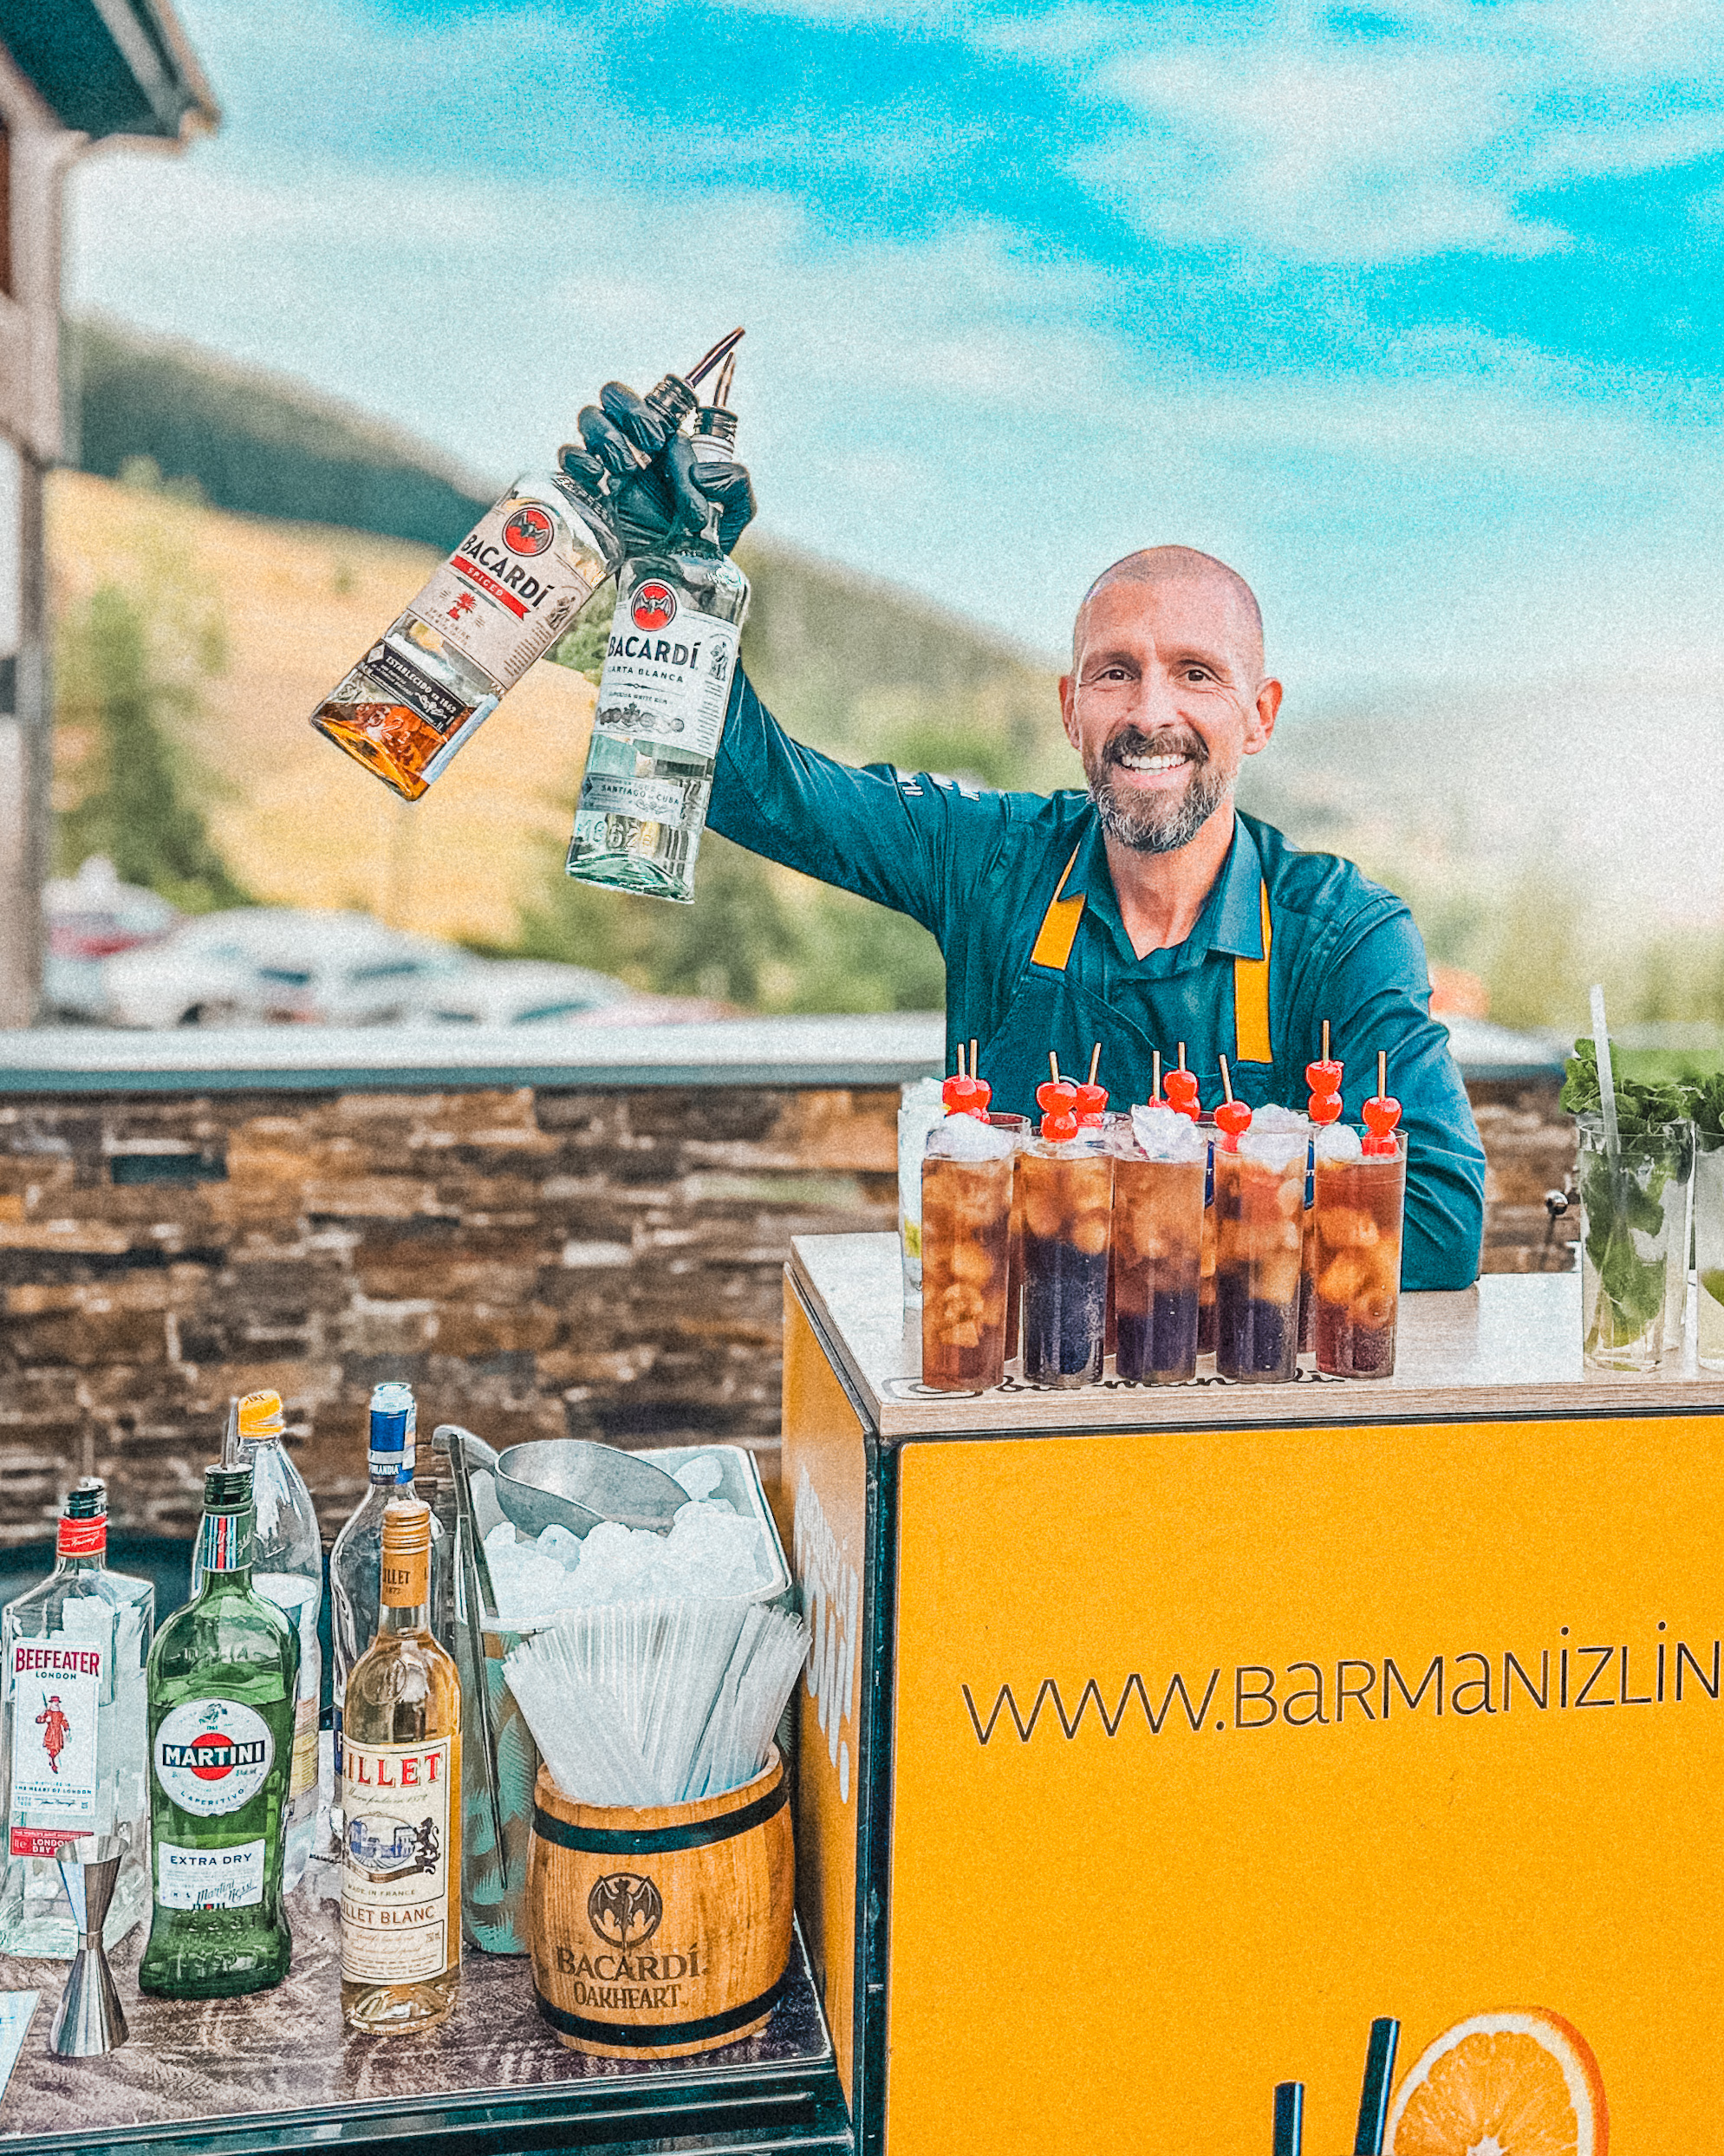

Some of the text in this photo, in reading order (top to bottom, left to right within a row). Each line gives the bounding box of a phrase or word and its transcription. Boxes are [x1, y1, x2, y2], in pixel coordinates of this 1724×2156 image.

[460, 534, 556, 608] BACARDÍ
[466, 566, 504, 597] SPICED
[608, 636, 702, 669] BACARDÍ
[385, 655, 433, 694] ESTABLECIDO
[638, 668, 683, 683] BLANCA
[601, 785, 647, 798] SANTIAGO
[656, 794, 679, 804] CUBA
[16, 1647, 100, 1677] BEEFEATER
[36, 1671, 76, 1680] LONDON
[166, 1742, 263, 1767] MARTINI
[344, 1751, 443, 1788] ILLET
[170, 1853, 252, 1866] EXTRA DRY
[348, 1883, 365, 1894] MADE
[381, 1905, 435, 1925] BLANC
[556, 1942, 701, 1982] BACARDÍ
[573, 1981, 682, 2009] OAKHEART
